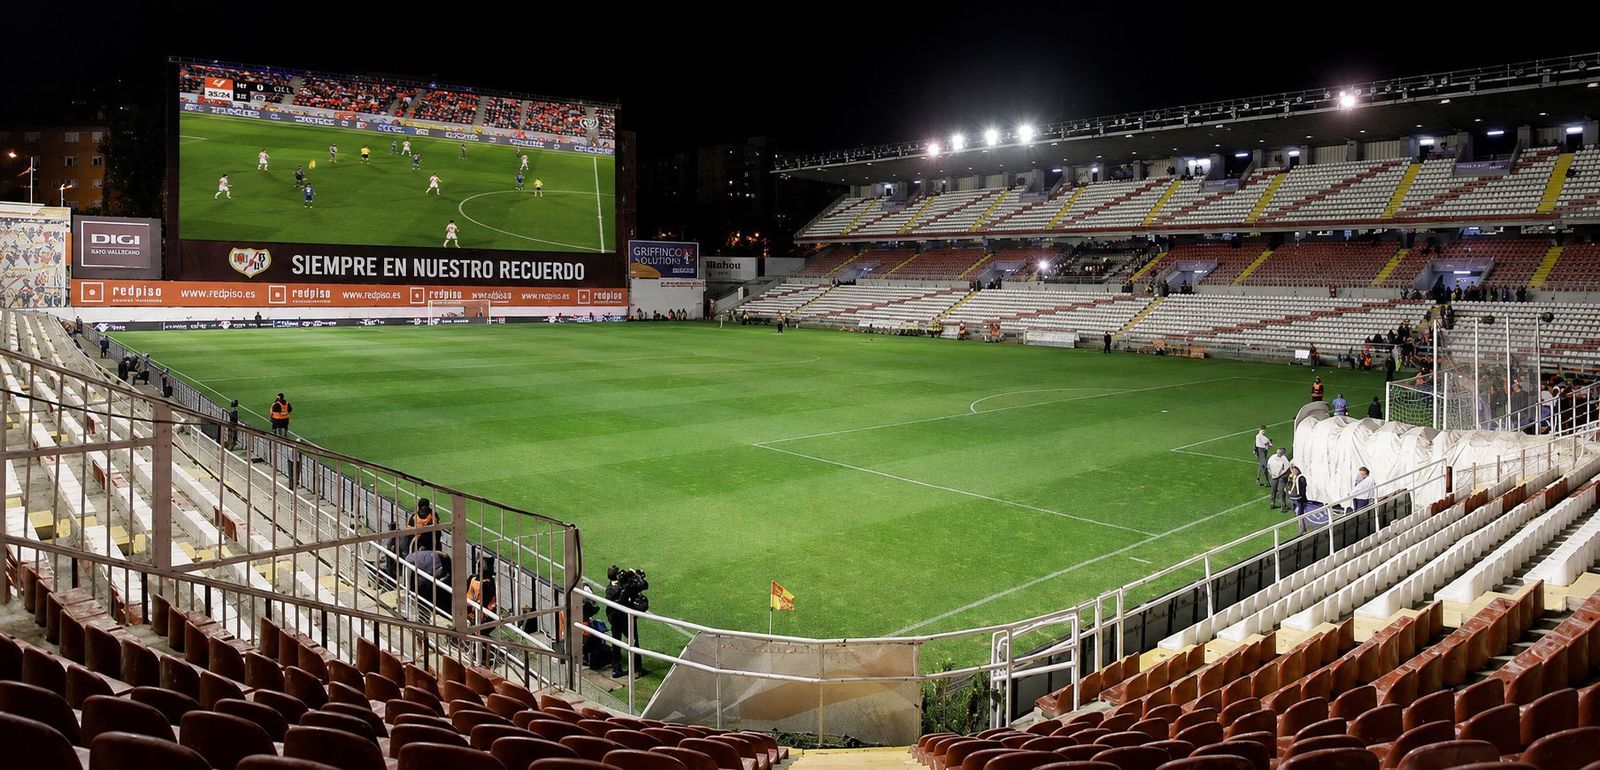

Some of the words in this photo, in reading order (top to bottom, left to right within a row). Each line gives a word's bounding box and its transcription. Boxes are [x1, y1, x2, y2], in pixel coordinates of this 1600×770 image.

[91, 234, 140, 245] DIGI
[292, 254, 377, 276] SIEMPRE
[383, 257, 406, 277] EN
[414, 258, 494, 278] NUESTRO
[500, 260, 585, 281] RECUERDO
[113, 284, 162, 298] redpiso
[181, 288, 256, 300] www.redpiso.es
[292, 288, 331, 300] redpiso
[342, 289, 401, 301] www.redpiso.es
